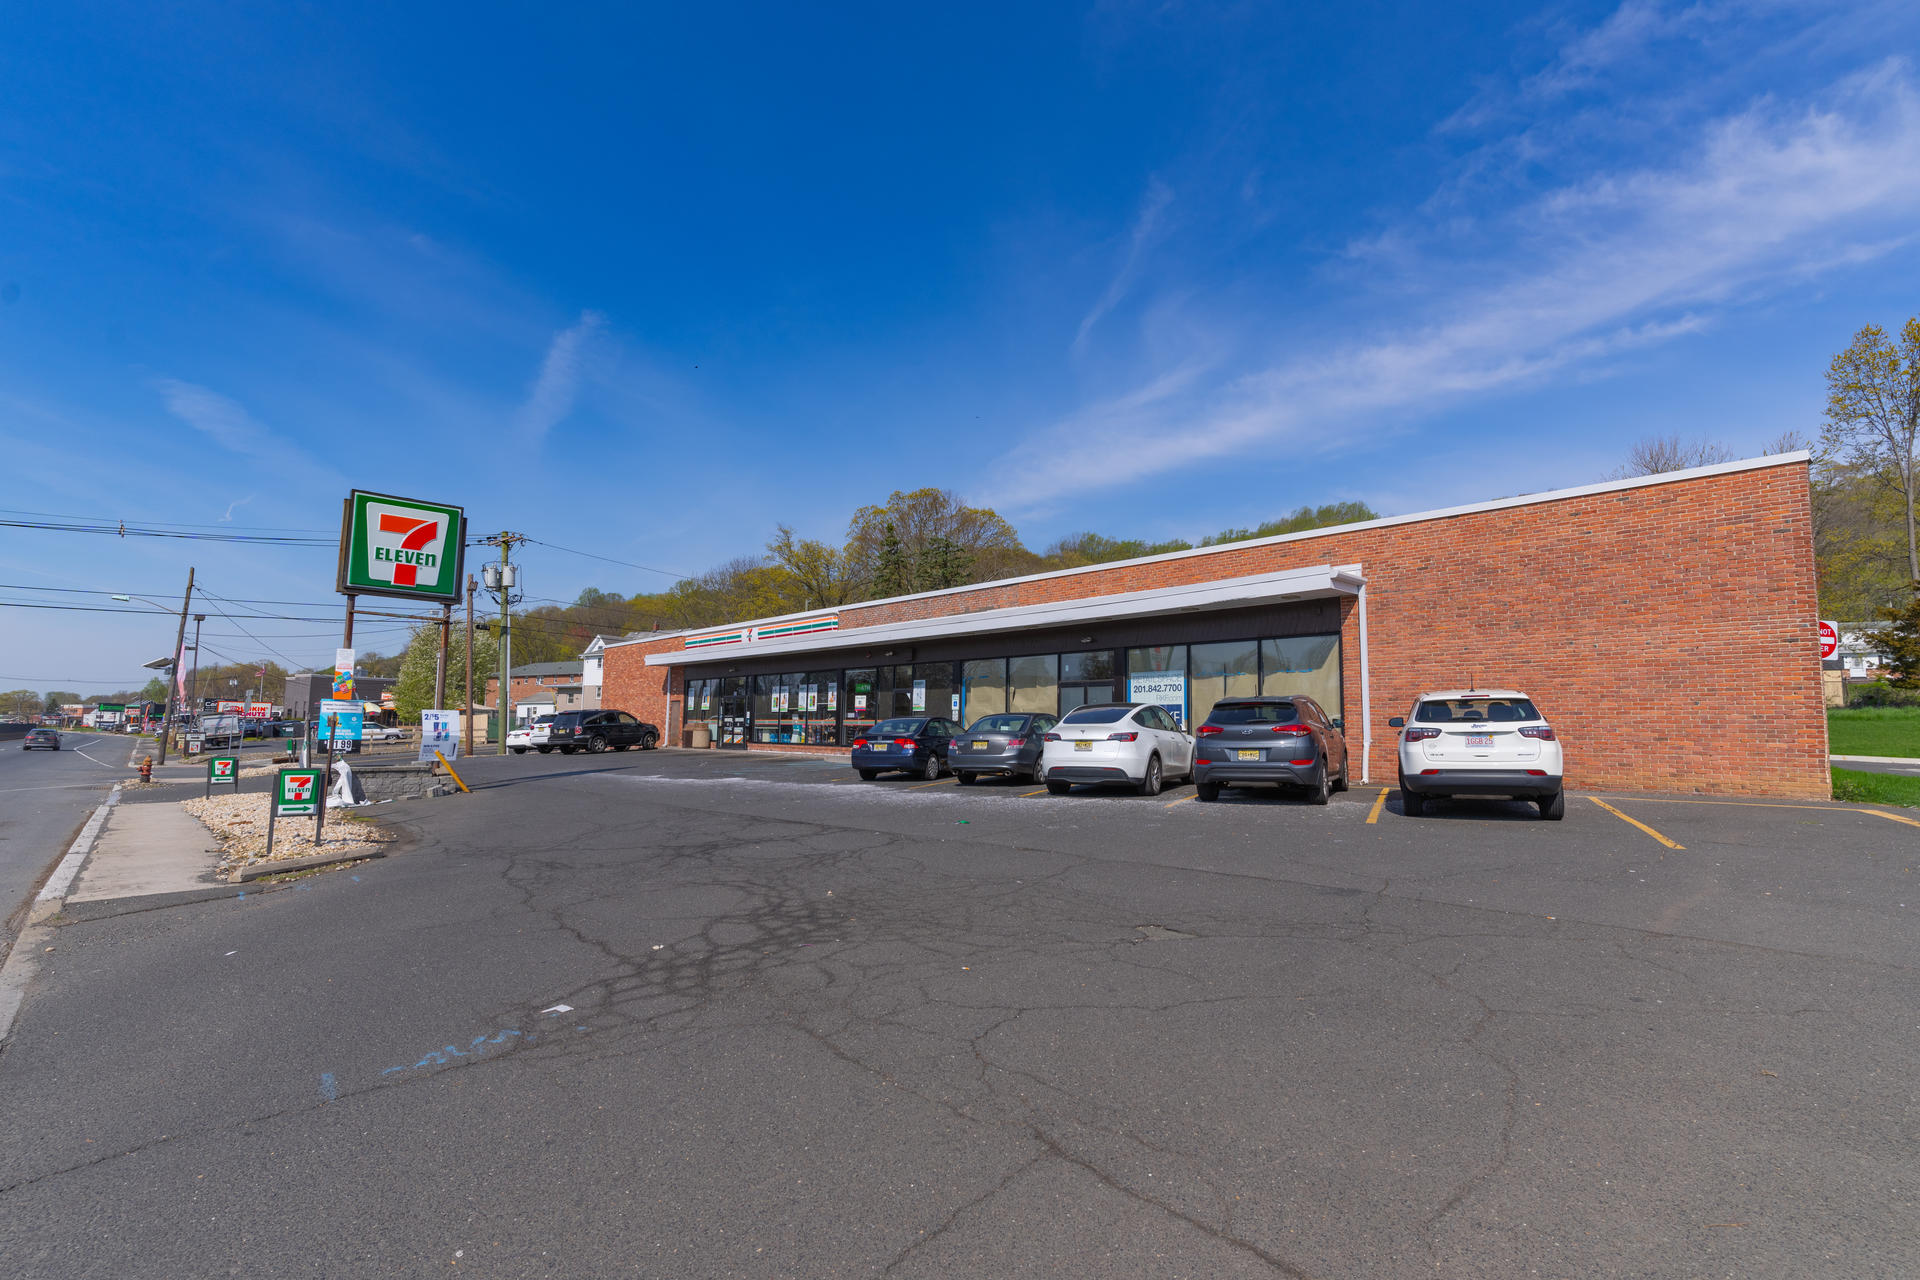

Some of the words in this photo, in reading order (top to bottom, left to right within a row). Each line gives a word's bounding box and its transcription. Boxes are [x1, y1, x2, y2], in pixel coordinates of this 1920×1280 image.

[379, 513, 438, 586] 7
[1133, 684, 1183, 693] 201.842.7700
[218, 762, 231, 775] 7
[289, 776, 311, 800] 7
